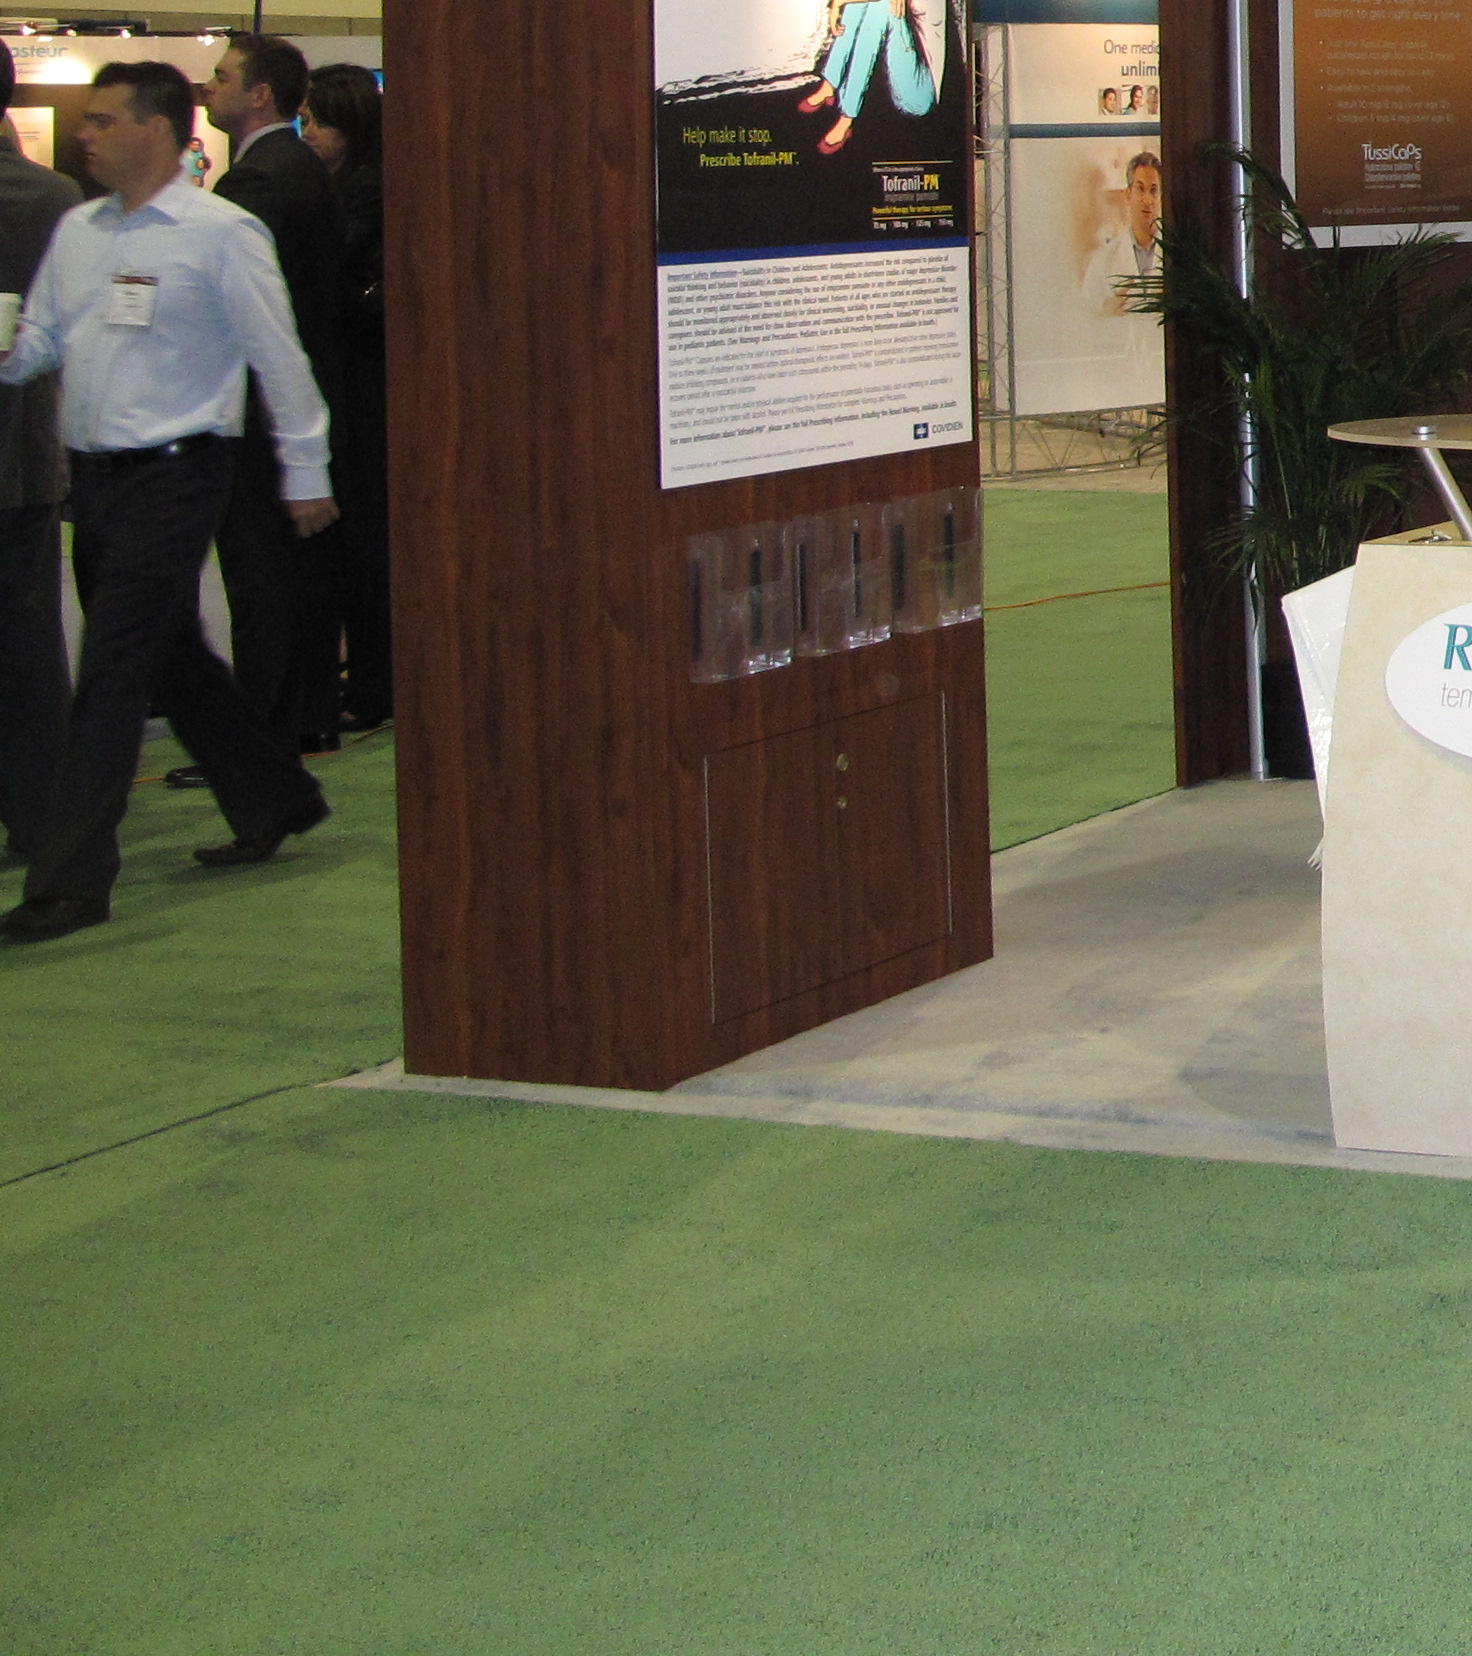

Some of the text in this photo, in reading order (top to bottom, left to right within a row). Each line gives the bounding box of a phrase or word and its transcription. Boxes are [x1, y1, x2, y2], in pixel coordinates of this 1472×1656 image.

[1104, 39, 1128, 54] One
[682, 127, 707, 144] Help
[709, 127, 736, 143] make
[738, 126, 746, 143] it
[700, 153, 741, 167] Prescribe
[932, 421, 964, 434] COVIDIEN
